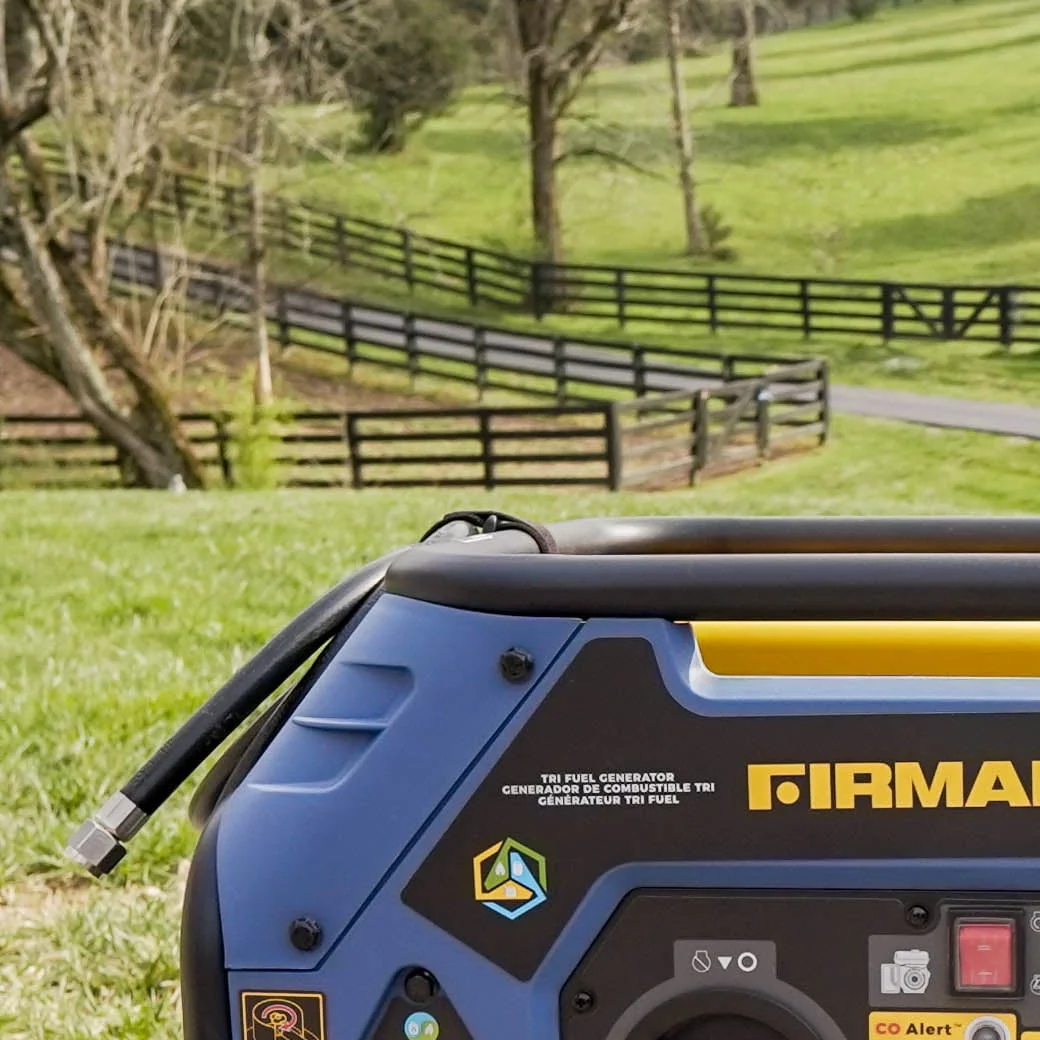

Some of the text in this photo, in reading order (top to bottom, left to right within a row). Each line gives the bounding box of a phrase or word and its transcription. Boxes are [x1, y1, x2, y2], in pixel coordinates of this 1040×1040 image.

[541, 773, 675, 783] TRI FUEL GENERATOR
[502, 783, 716, 795] GENERADOR DE COMBUSTIBLE TRI
[538, 794, 679, 806] GÉNÉRATEUR TRI FUEL
[876, 1023, 952, 1035] CO Alert
